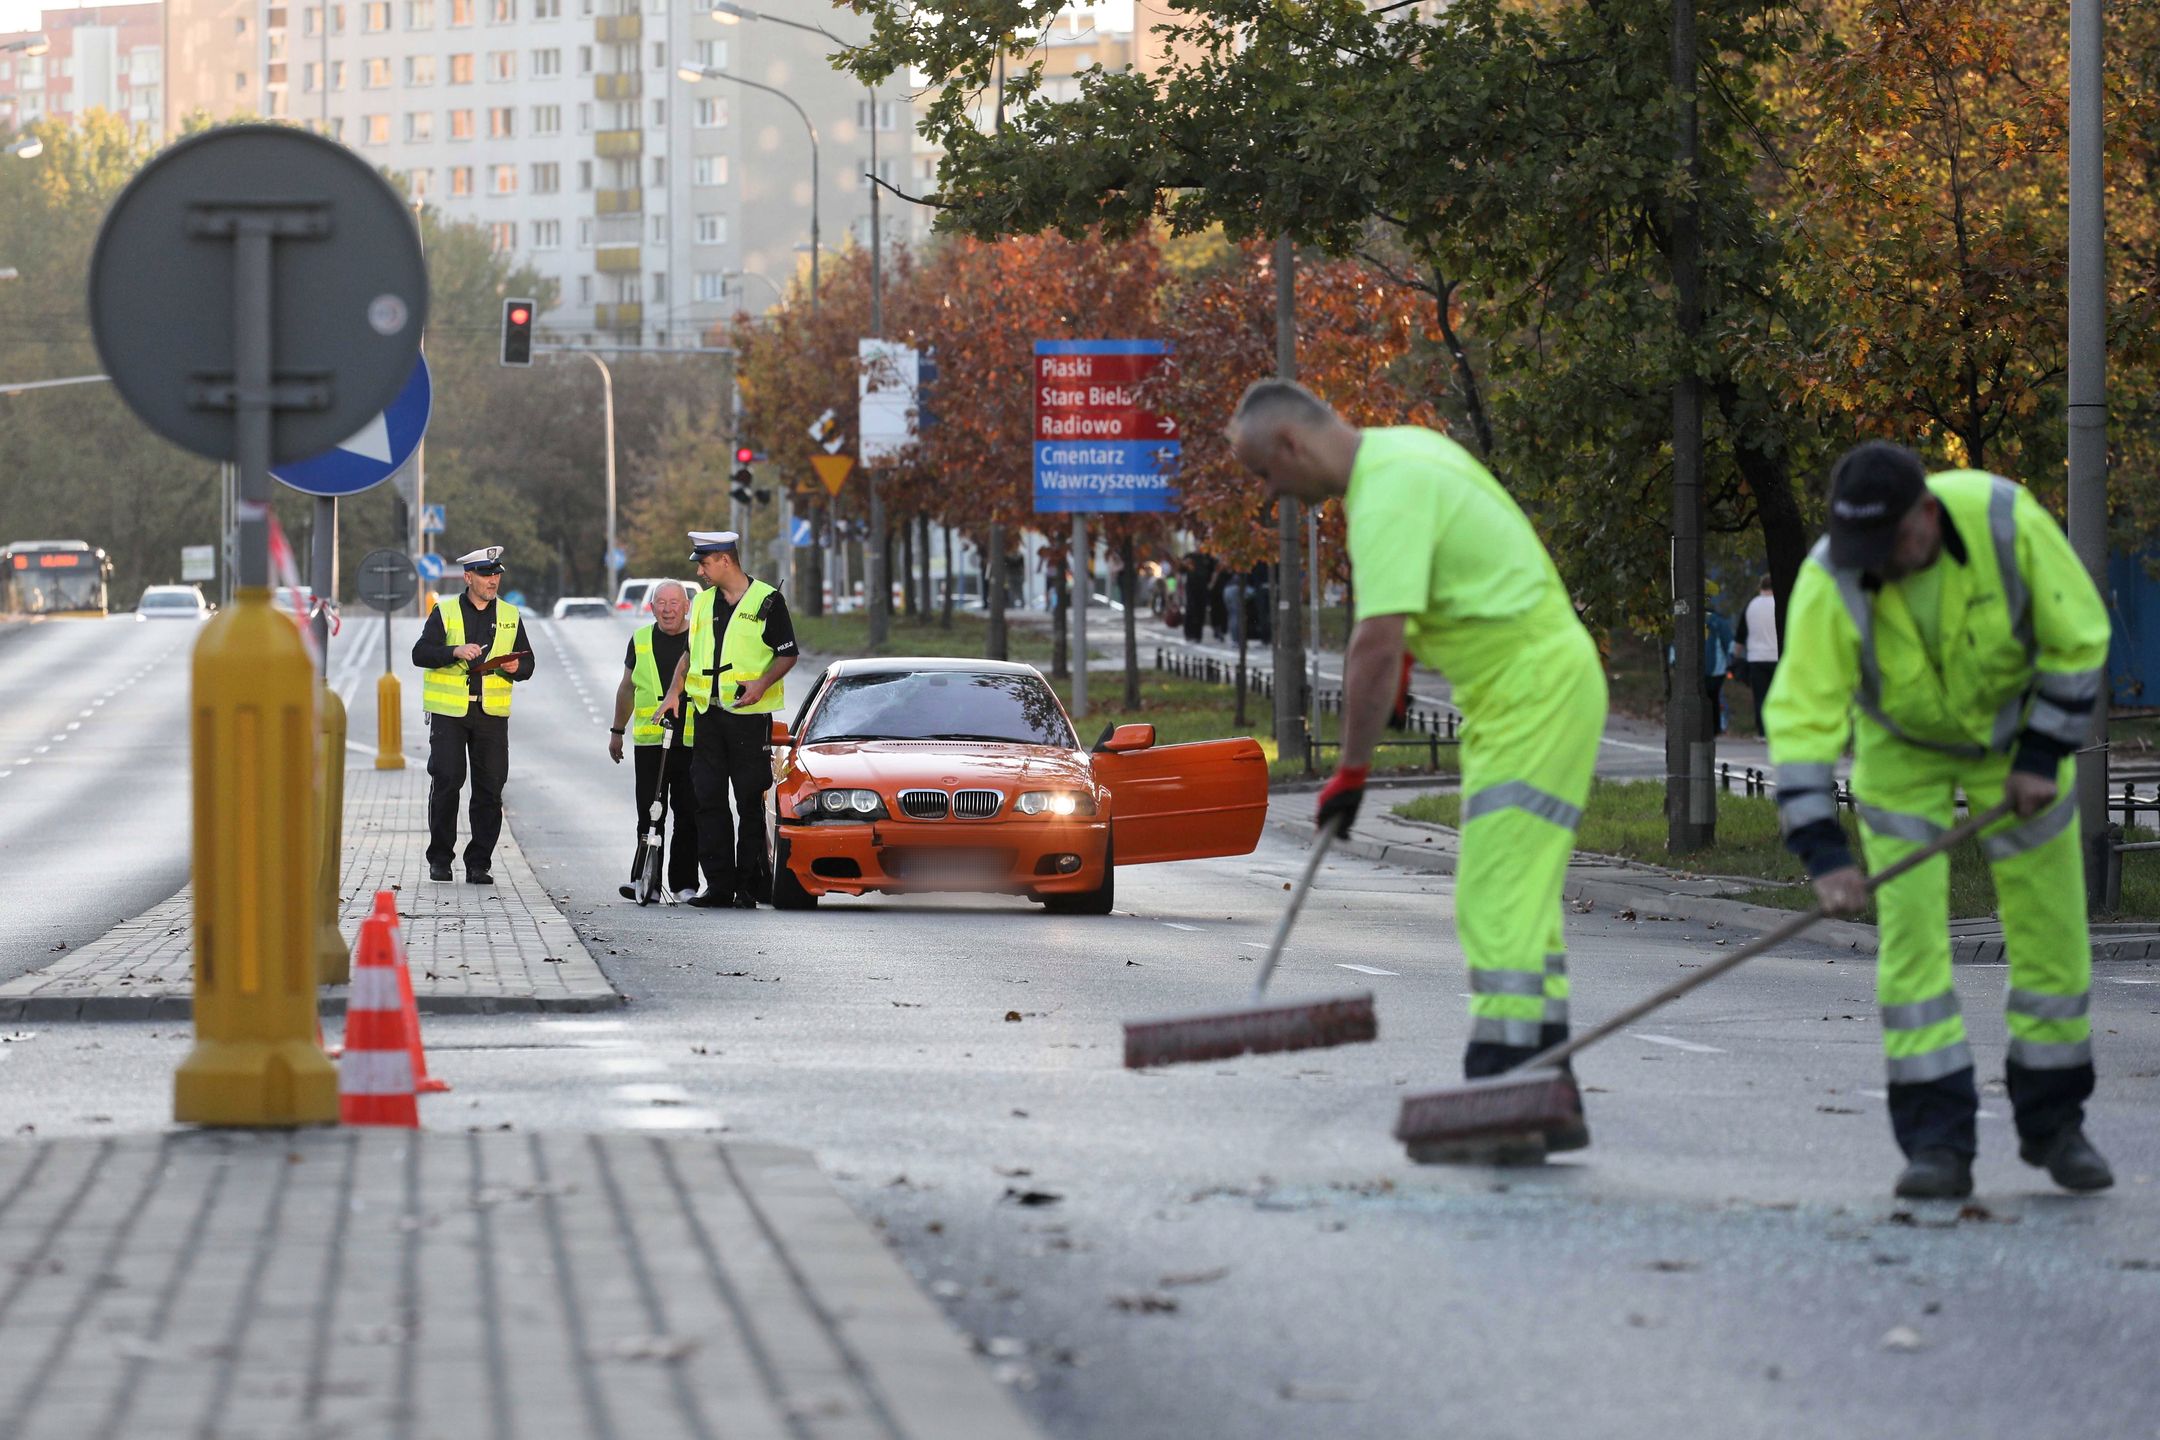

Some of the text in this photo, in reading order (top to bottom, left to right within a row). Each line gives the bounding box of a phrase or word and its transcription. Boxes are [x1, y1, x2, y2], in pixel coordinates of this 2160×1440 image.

[1042, 358, 1092, 377] Piaski
[1042, 386, 1150, 409] Stare Biela
[1042, 414, 1122, 434] Radiowo
[1041, 446, 1124, 465] Cmentarz
[1041, 471, 1169, 493] Wawrzyszewsk
